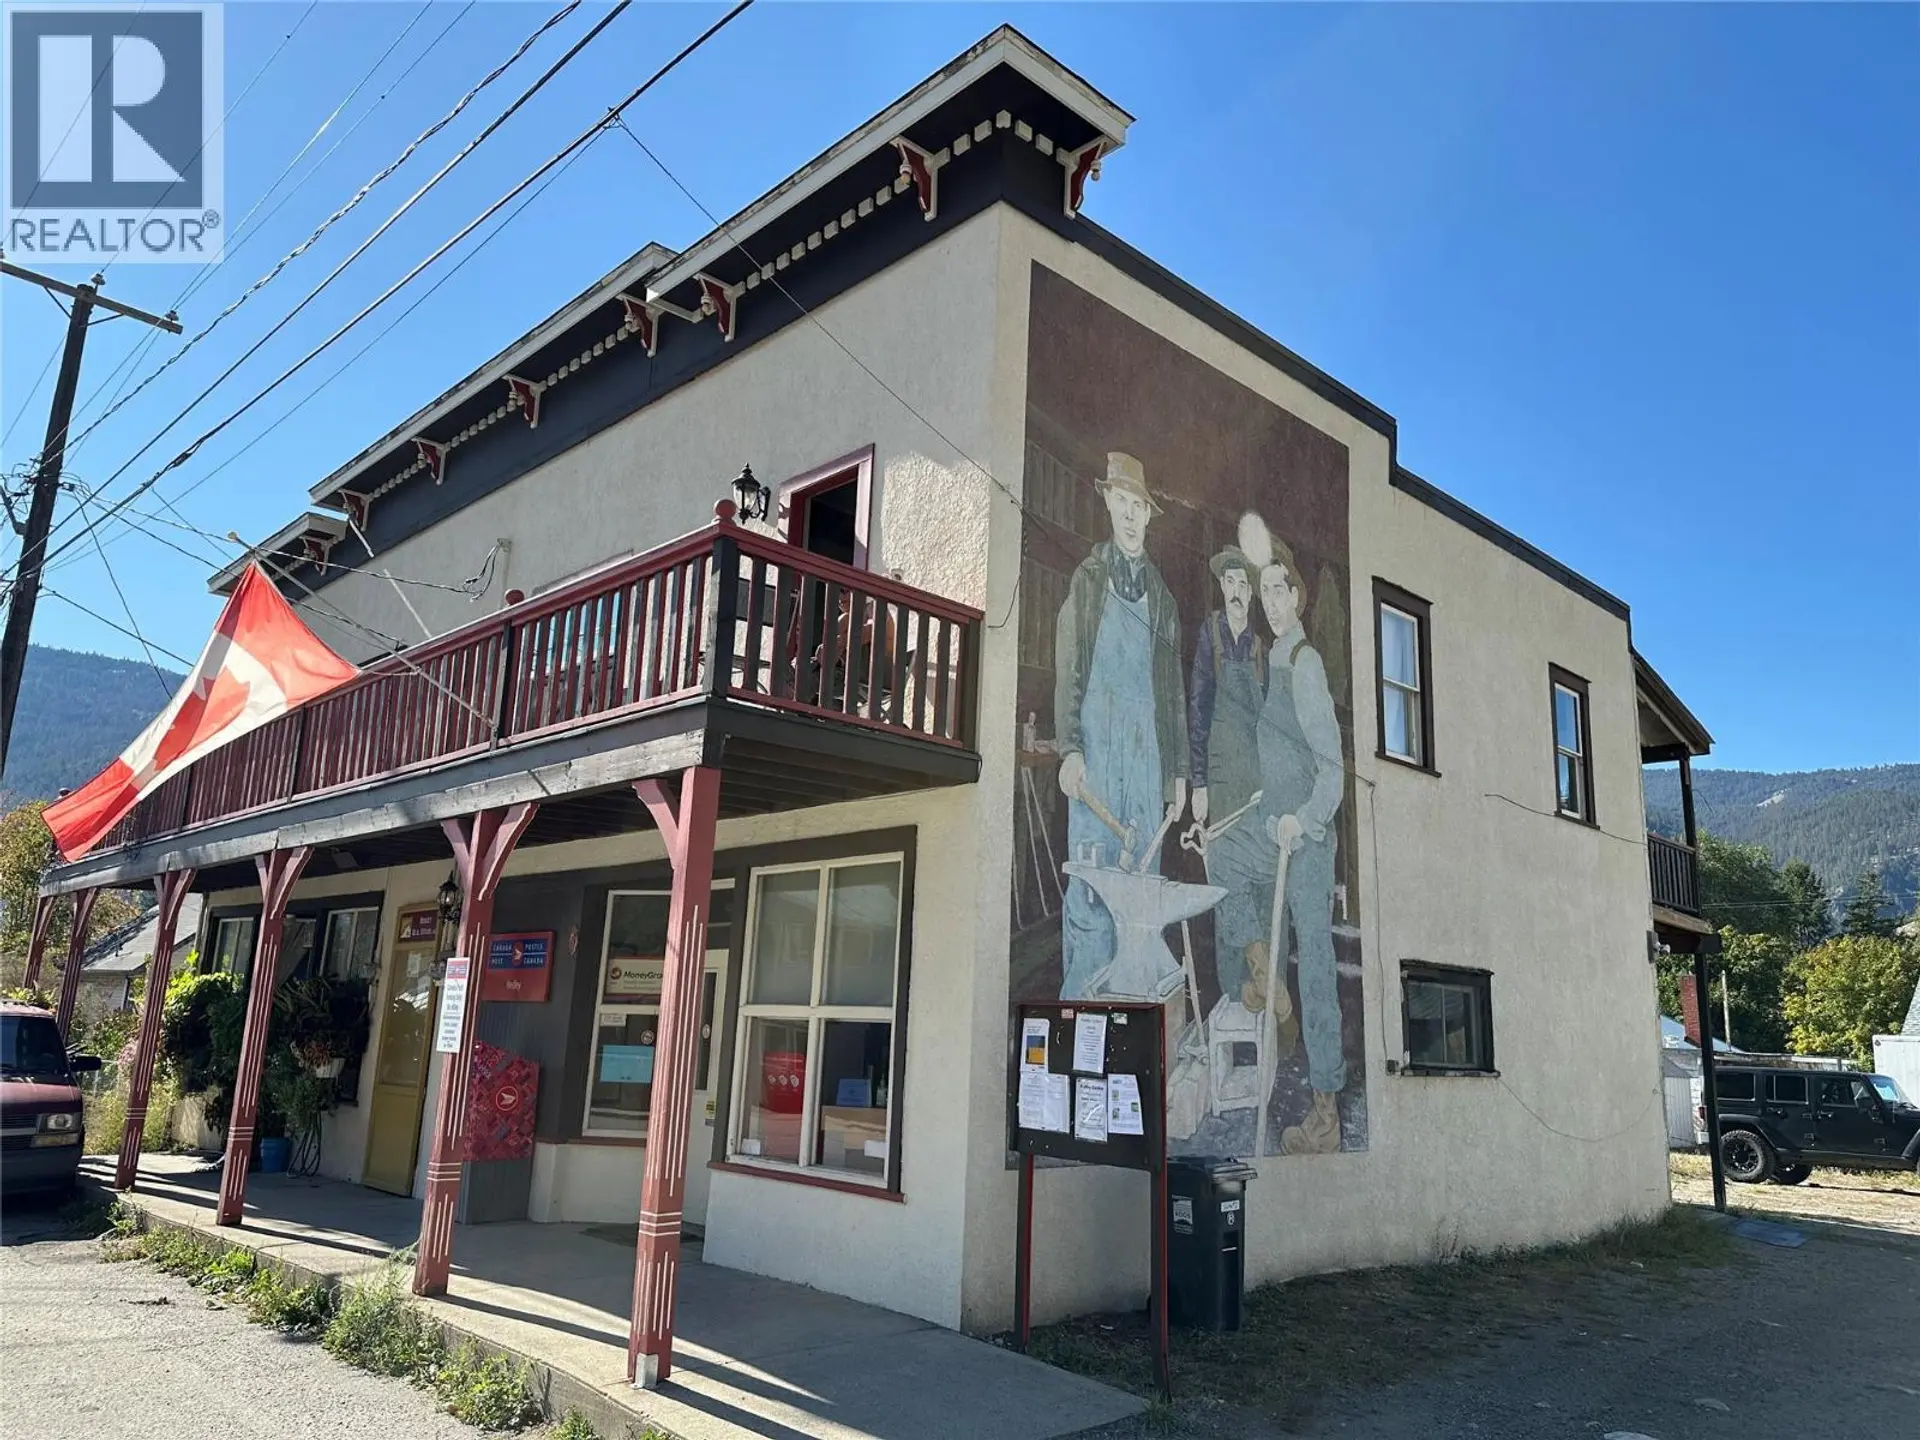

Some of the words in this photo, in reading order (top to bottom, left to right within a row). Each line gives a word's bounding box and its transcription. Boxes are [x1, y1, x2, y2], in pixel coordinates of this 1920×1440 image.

[492, 943, 512, 952] CANADA
[523, 957, 544, 965] CANADA
[623, 970, 663, 980] MoneyGra
